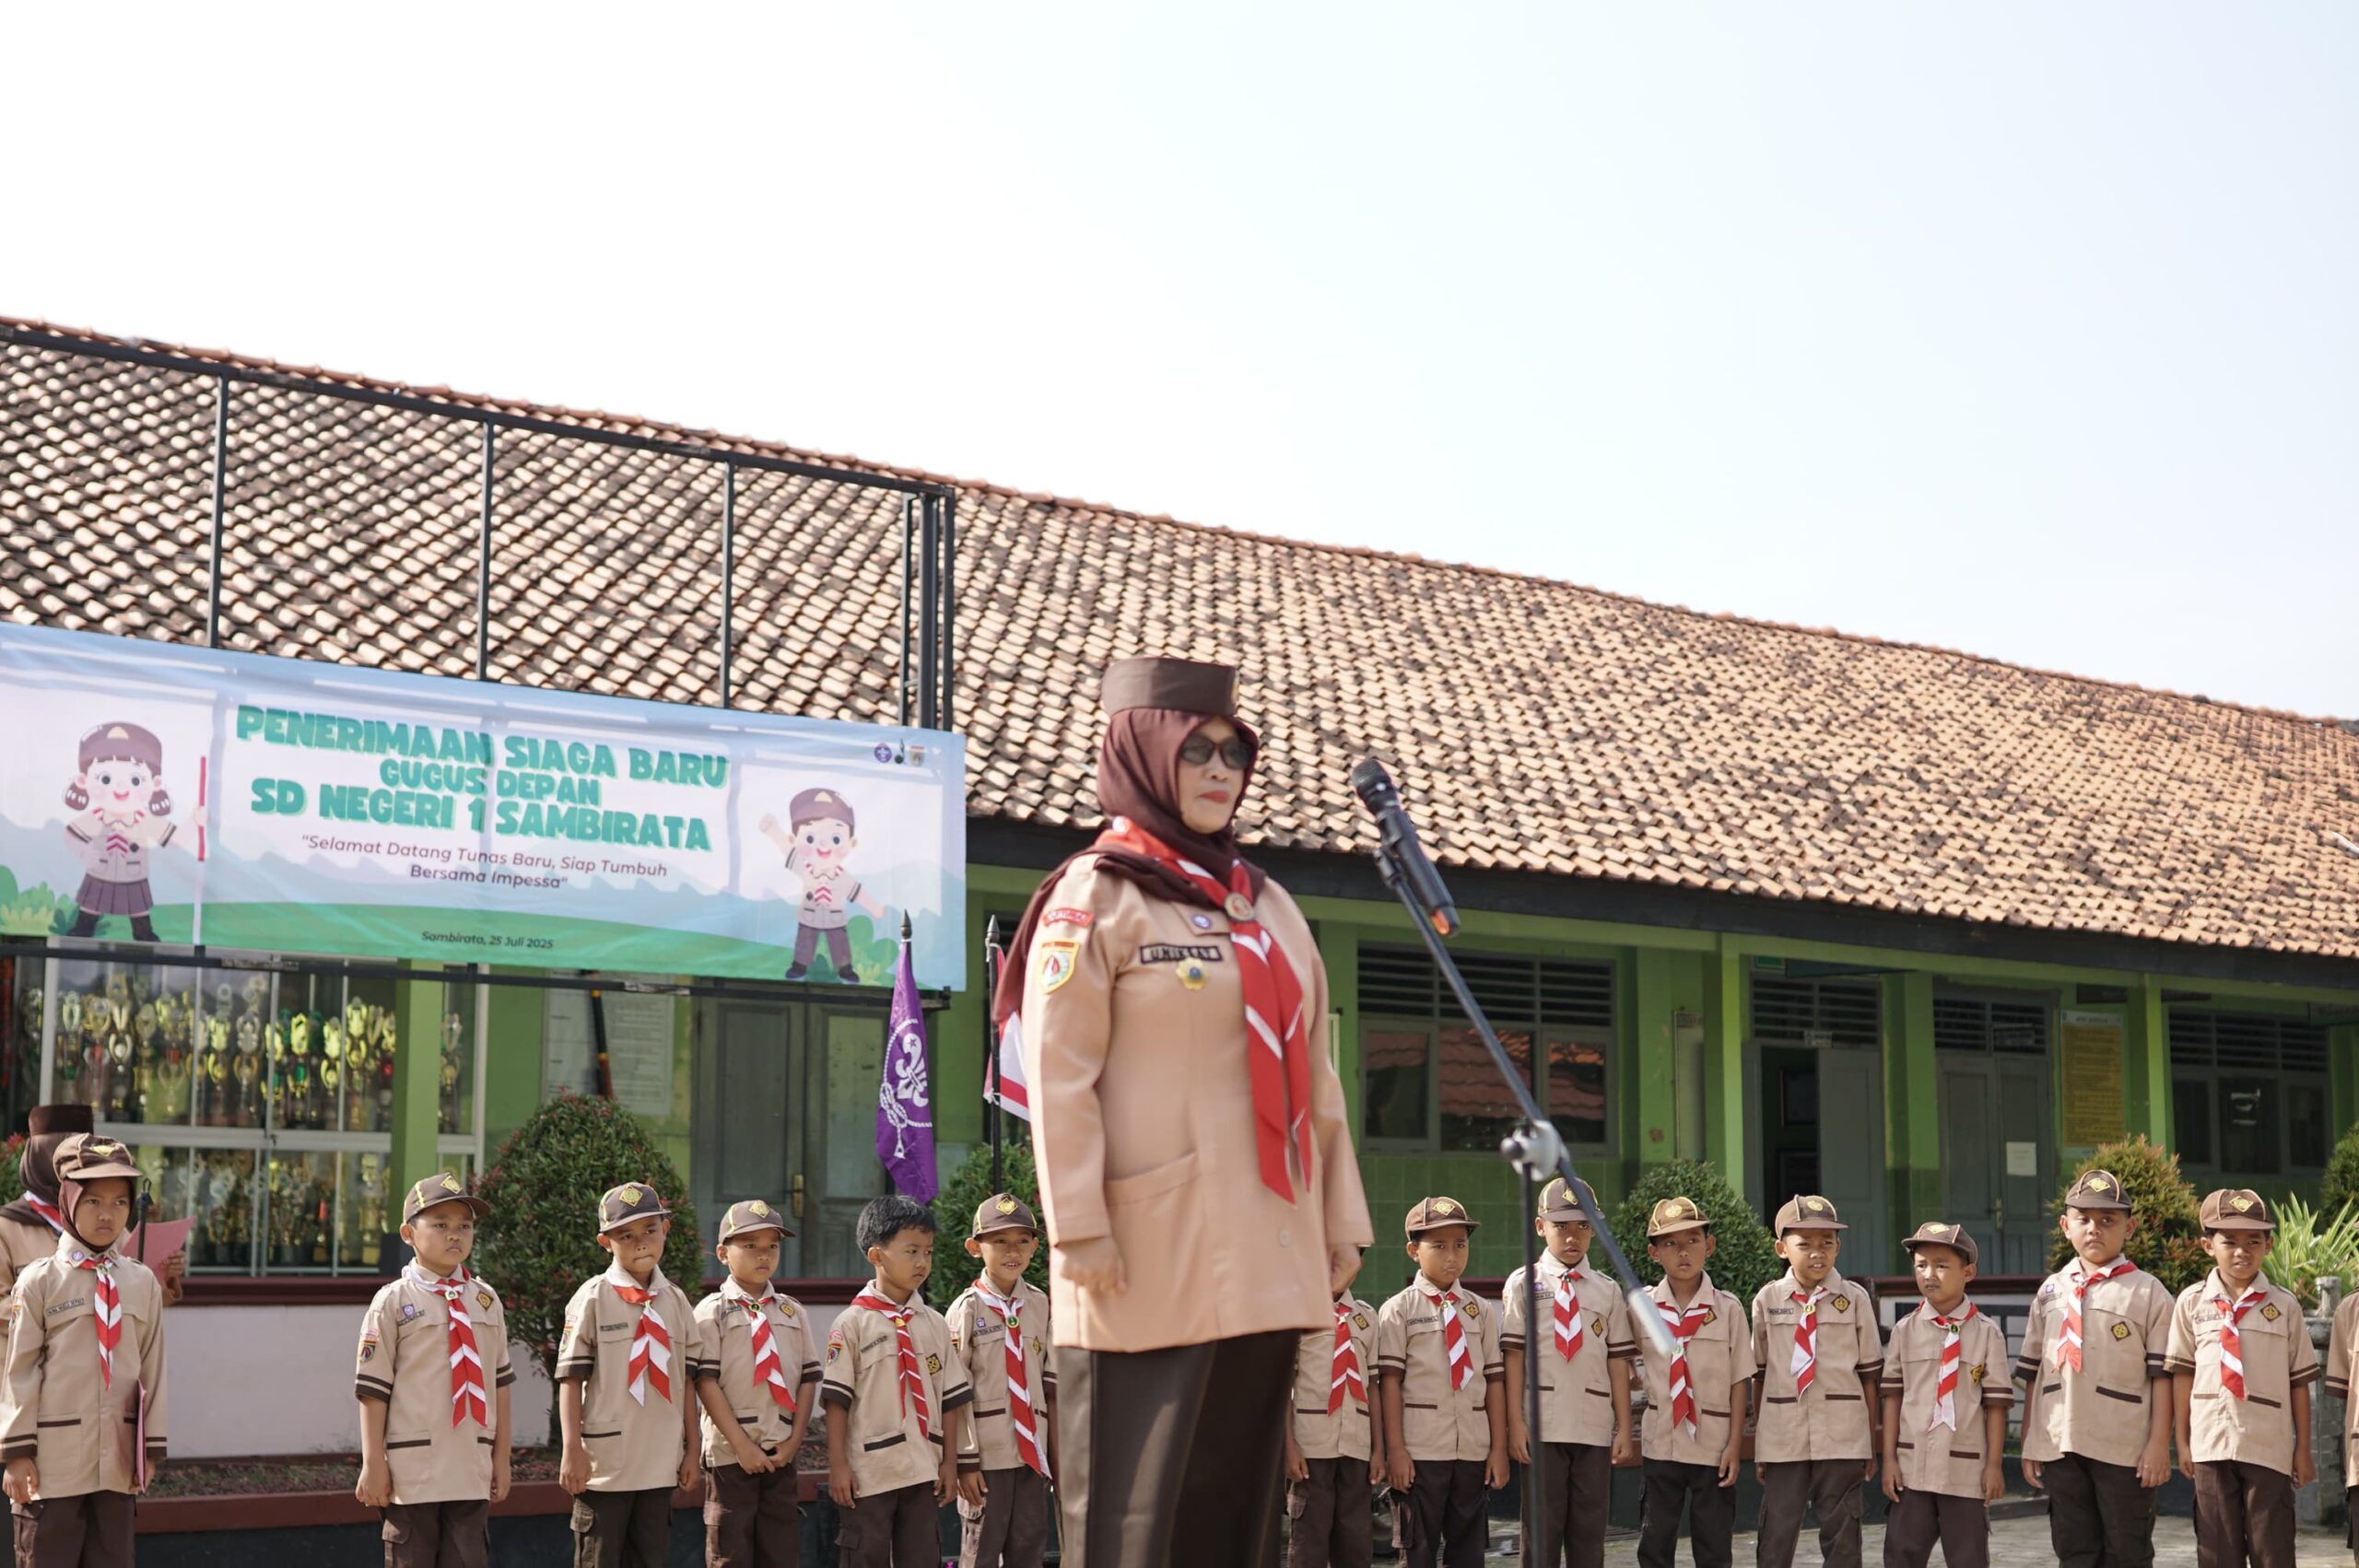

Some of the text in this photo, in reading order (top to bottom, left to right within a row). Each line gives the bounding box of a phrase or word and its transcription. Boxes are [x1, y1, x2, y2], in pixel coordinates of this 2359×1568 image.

[237, 704, 728, 788] PENERIMAAN SIAGA BARU
[380, 758, 602, 807] GUGUS DEPAN
[251, 778, 713, 852] SD NEGERI 1 SAMBIRATA
[301, 835, 667, 877] "Selamat Datang Tunas Baru, Siap Tumbuh
[410, 864, 569, 889] Bersama Impessa"
[421, 930, 553, 950] Sambirata, 25 Juli 2025
